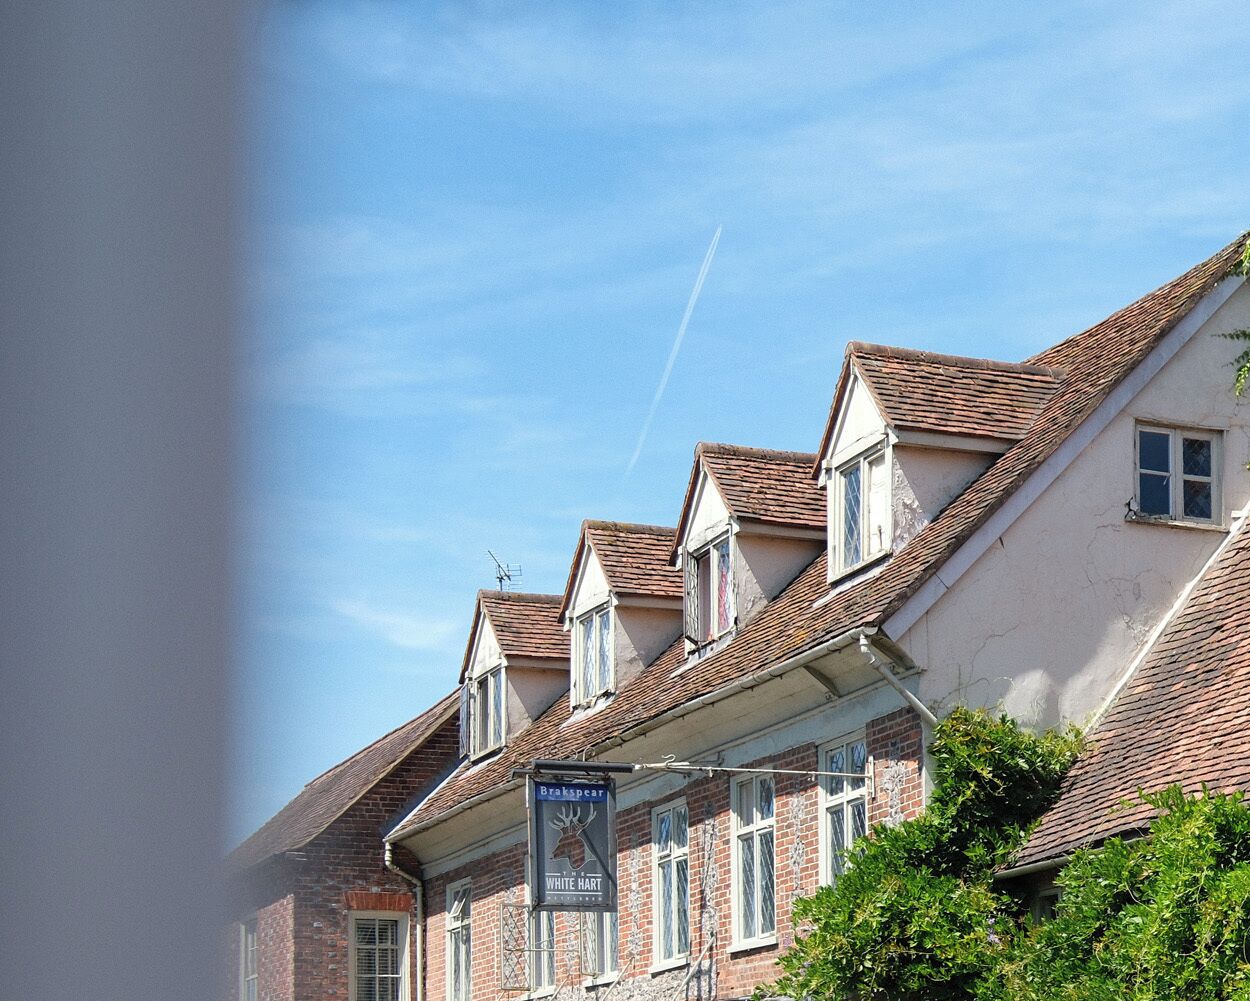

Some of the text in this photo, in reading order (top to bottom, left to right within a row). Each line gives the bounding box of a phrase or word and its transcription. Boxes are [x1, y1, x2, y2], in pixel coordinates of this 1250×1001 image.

[540, 786, 604, 798] Brakspear
[546, 877, 602, 891] WHITE HART
